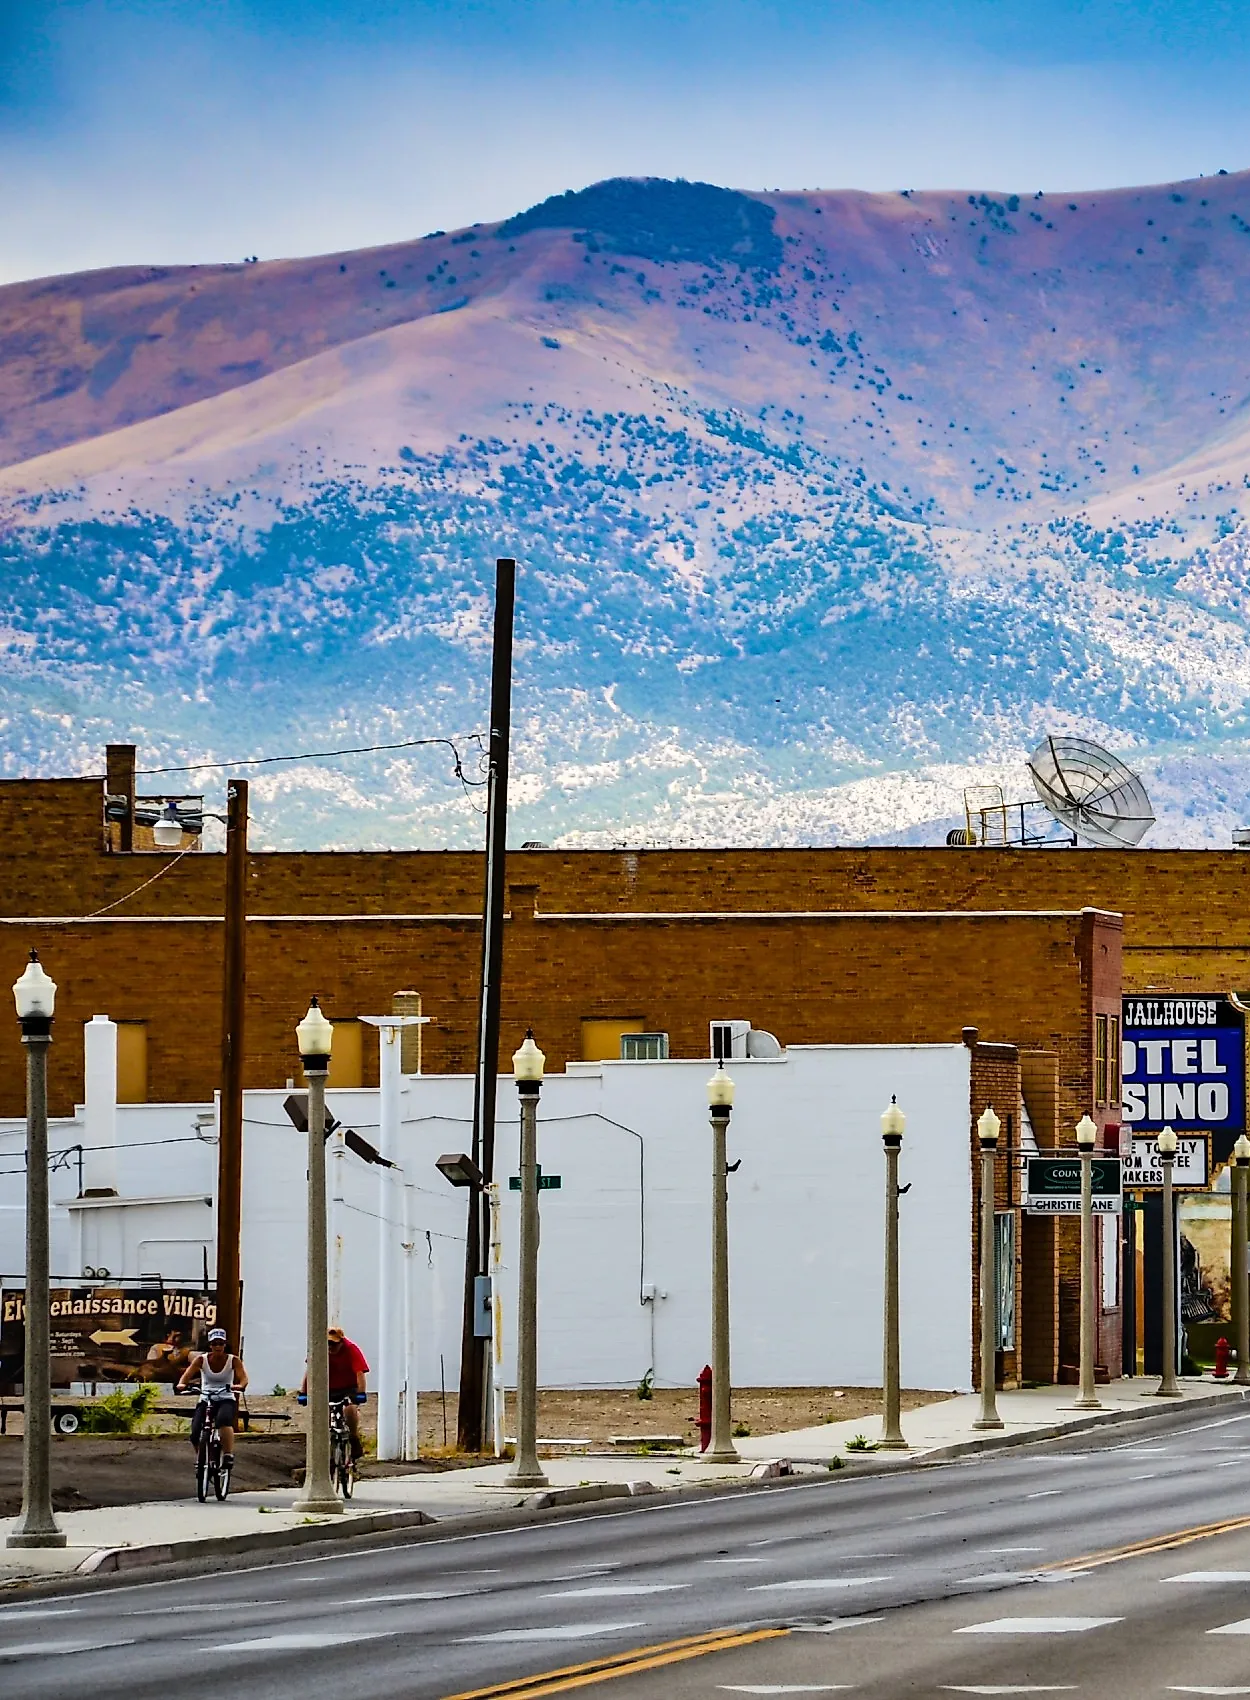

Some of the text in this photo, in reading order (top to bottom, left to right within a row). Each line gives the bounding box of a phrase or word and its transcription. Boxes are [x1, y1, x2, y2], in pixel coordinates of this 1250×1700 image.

[1125, 1001, 1217, 1026] JAILHOUSE
[1122, 1039, 1227, 1075] TEL
[1122, 1082, 1229, 1121] SINO
[1052, 1169, 1096, 1178] COUNY
[1122, 1155, 1191, 1168] OM COFEE
[1035, 1200, 1082, 1211] CHRISTIE
[1090, 1200, 1113, 1211] ANE
[50, 1294, 158, 1317] enaissance
[163, 1294, 218, 1326] Villag
